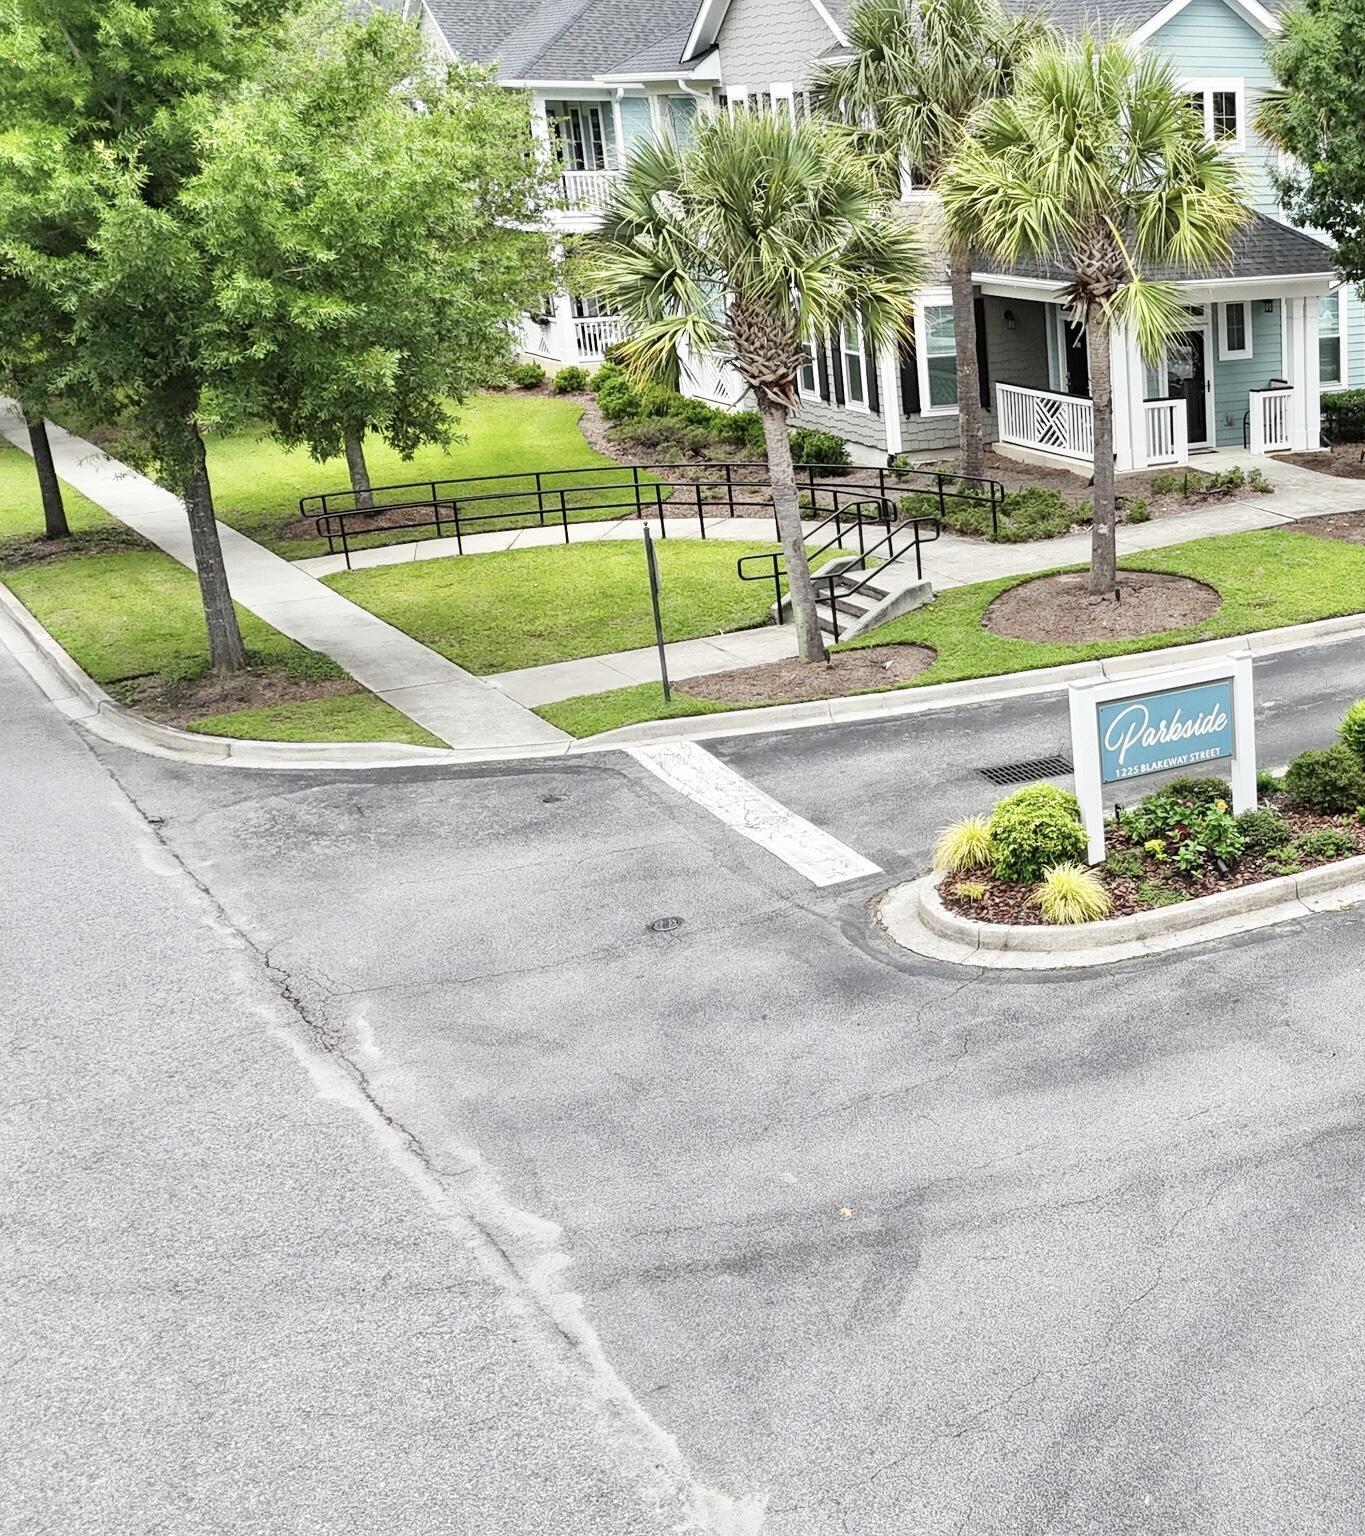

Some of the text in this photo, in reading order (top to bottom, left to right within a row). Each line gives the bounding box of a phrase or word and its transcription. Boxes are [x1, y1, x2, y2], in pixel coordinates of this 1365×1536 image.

[1105, 703, 1228, 765] Parkside
[1115, 747, 1221, 778] 1225 BLAKEWAY STREET
